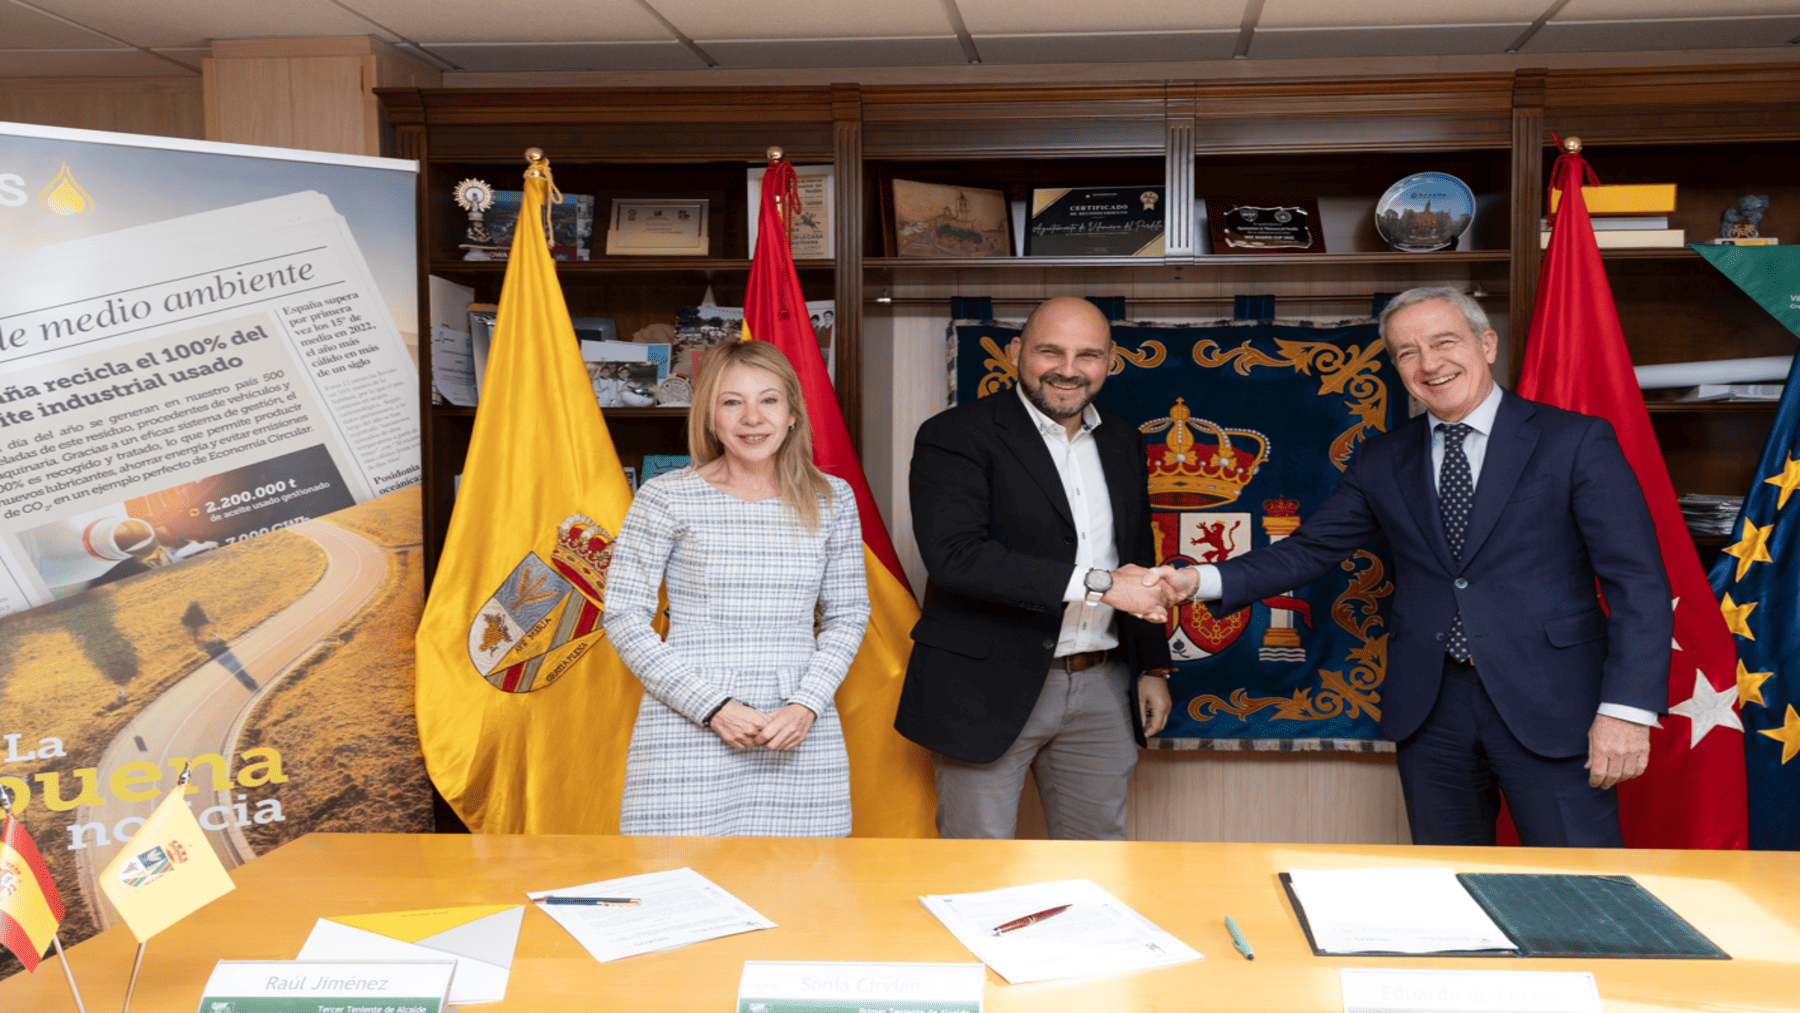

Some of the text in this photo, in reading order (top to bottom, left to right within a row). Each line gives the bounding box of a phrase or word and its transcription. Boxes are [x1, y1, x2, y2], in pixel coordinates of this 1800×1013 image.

[1069, 204, 1129, 212] CERTIFICADO
[38, 298, 152, 341] medio
[163, 263, 315, 312] ambiente
[282, 292, 359, 315] España supera
[288, 305, 353, 328] por primera
[294, 326, 312, 336] vez
[313, 322, 330, 332] los
[349, 313, 362, 323] de
[300, 321, 377, 347] media en 2022,
[305, 337, 361, 357] el año más
[43, 361, 134, 393] recicla
[136, 351, 160, 369] el
[161, 335, 227, 364] 100%
[230, 325, 269, 346] del
[311, 343, 380, 368] cálido en más
[317, 356, 371, 378] de un siglo
[36, 372, 168, 418] industrial
[168, 356, 244, 383] usado
[7, 369, 285, 450] día del año se generan en nuestro país 500
[40, 444, 56, 455] de
[58, 438, 84, 450] este
[85, 424, 135, 443] residuo,
[136, 404, 210, 430] procedentes
[211, 399, 226, 409] de
[226, 384, 282, 404] vehículos
[282, 381, 291, 391] y
[61, 444, 109, 462] Gracias
[111, 441, 119, 449] a
[120, 435, 139, 446] un
[140, 425, 176, 441] eficaz
[177, 413, 222, 431] sistema
[223, 408, 239, 418] de
[240, 396, 285, 415] gestión,
[286, 391, 298, 401] el
[28, 475, 42, 485] es
[45, 459, 102, 480] recogido
[104, 455, 114, 466] y
[116, 443, 163, 461] tratado,
[165, 437, 178, 447] lo
[180, 431, 204, 444] que
[206, 417, 252, 438] permite
[254, 402, 303, 425] producir
[44, 467, 118, 494] lubricantes,
[118, 453, 164, 474] ahorrar
[164, 440, 209, 461] energía
[209, 439, 218, 450] y
[218, 429, 251, 445] evitar
[252, 414, 309, 436] emisiones
[4, 509, 21, 520] de
[53, 494, 71, 505] en
[72, 488, 91, 501] un
[91, 473, 141, 495] ejemplo
[141, 459, 191, 481] perfecto
[191, 454, 208, 466] de
[207, 438, 267, 461] Economía
[267, 425, 315, 444] Circular.
[373, 464, 420, 485] Posidonia
[205, 478, 297, 514] 2.200.000 t
[209, 481, 330, 522] de aceite usado gestionado
[3, 733, 67, 763] La
[66, 794, 286, 850] nocia
[265, 975, 389, 991] Raúl Jiménez
[800, 976, 921, 994] Sonia Cirvián
[1381, 985, 1461, 1002] Eduardo
[318, 1005, 346, 1013] Tercer
[347, 1005, 383, 1013] Teniente
